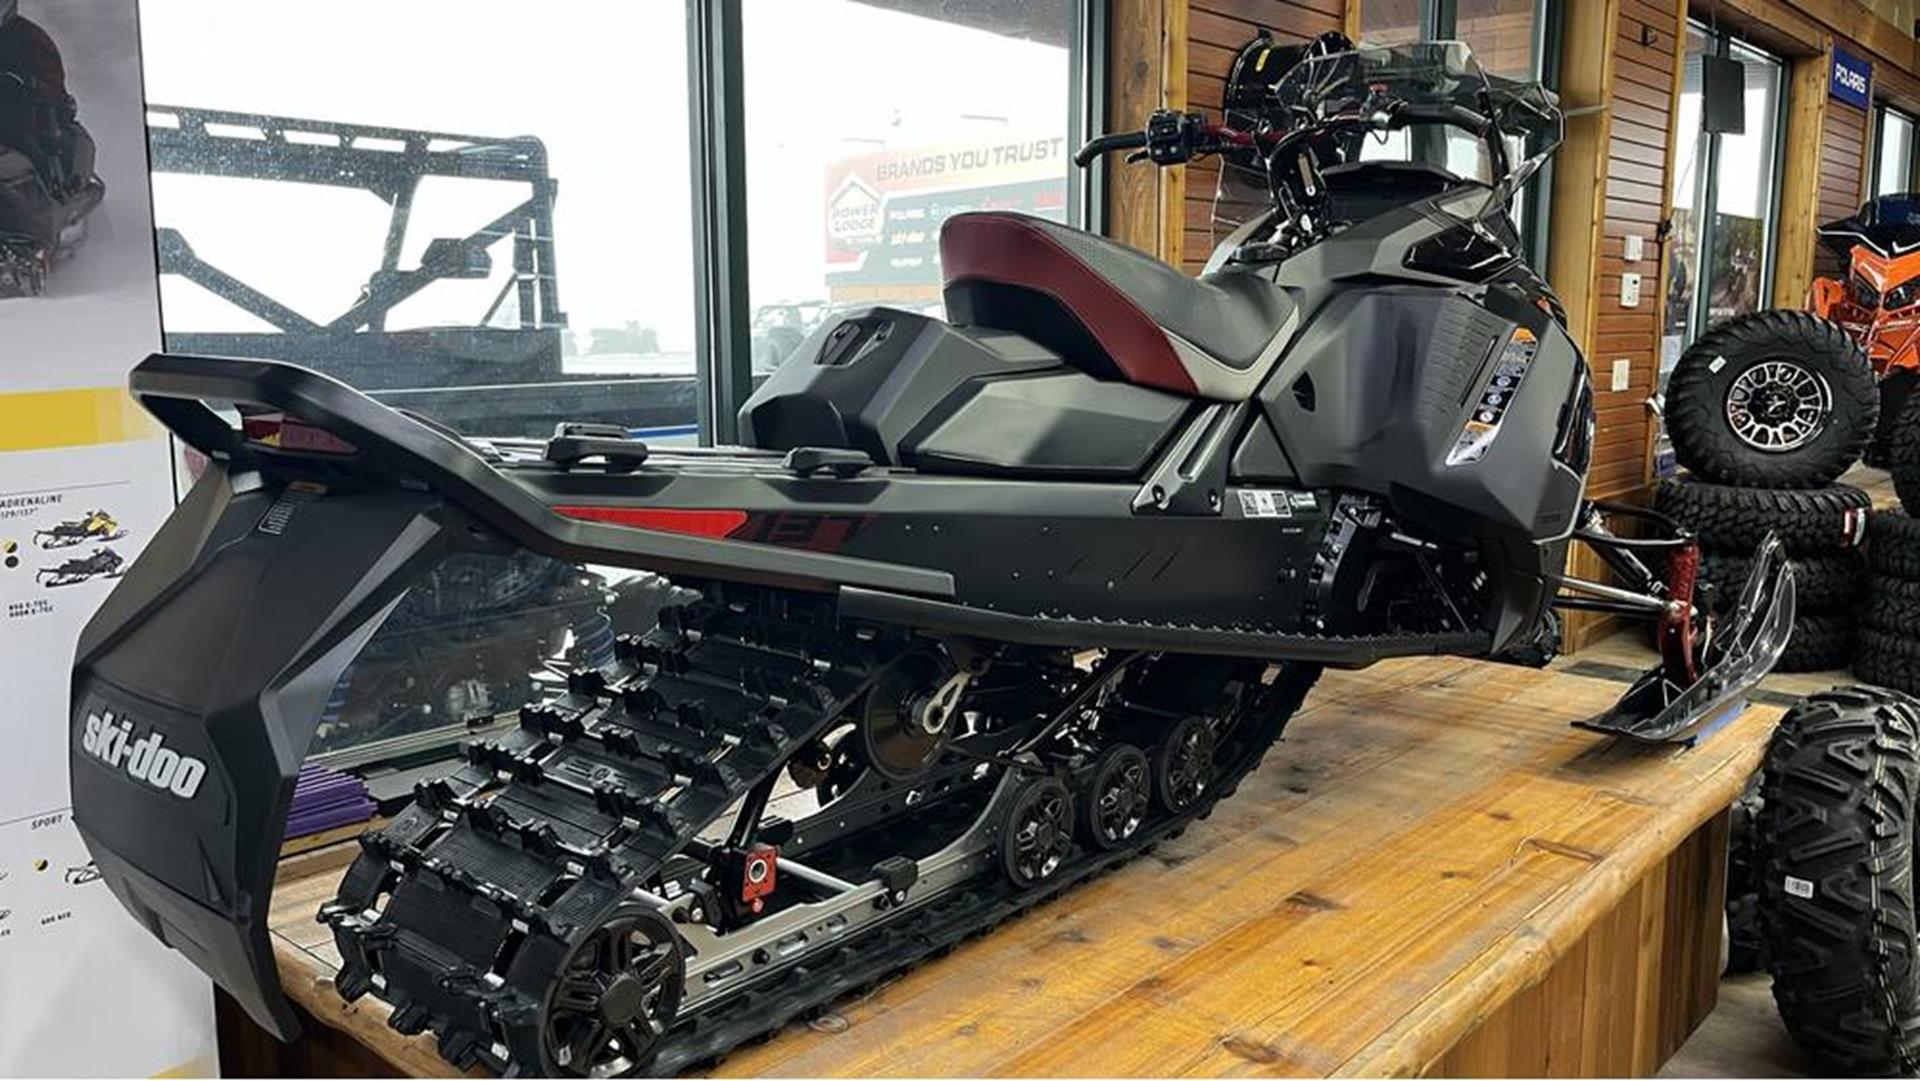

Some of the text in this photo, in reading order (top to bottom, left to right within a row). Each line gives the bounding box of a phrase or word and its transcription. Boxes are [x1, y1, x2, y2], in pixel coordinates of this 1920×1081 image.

[1834, 62, 1866, 94] POLARIS
[876, 137, 1063, 181] BRANDS YOU TRUST
[832, 204, 878, 221] POWER
[82, 711, 207, 799] ski-doo
[31, 814, 63, 830] SPORT
